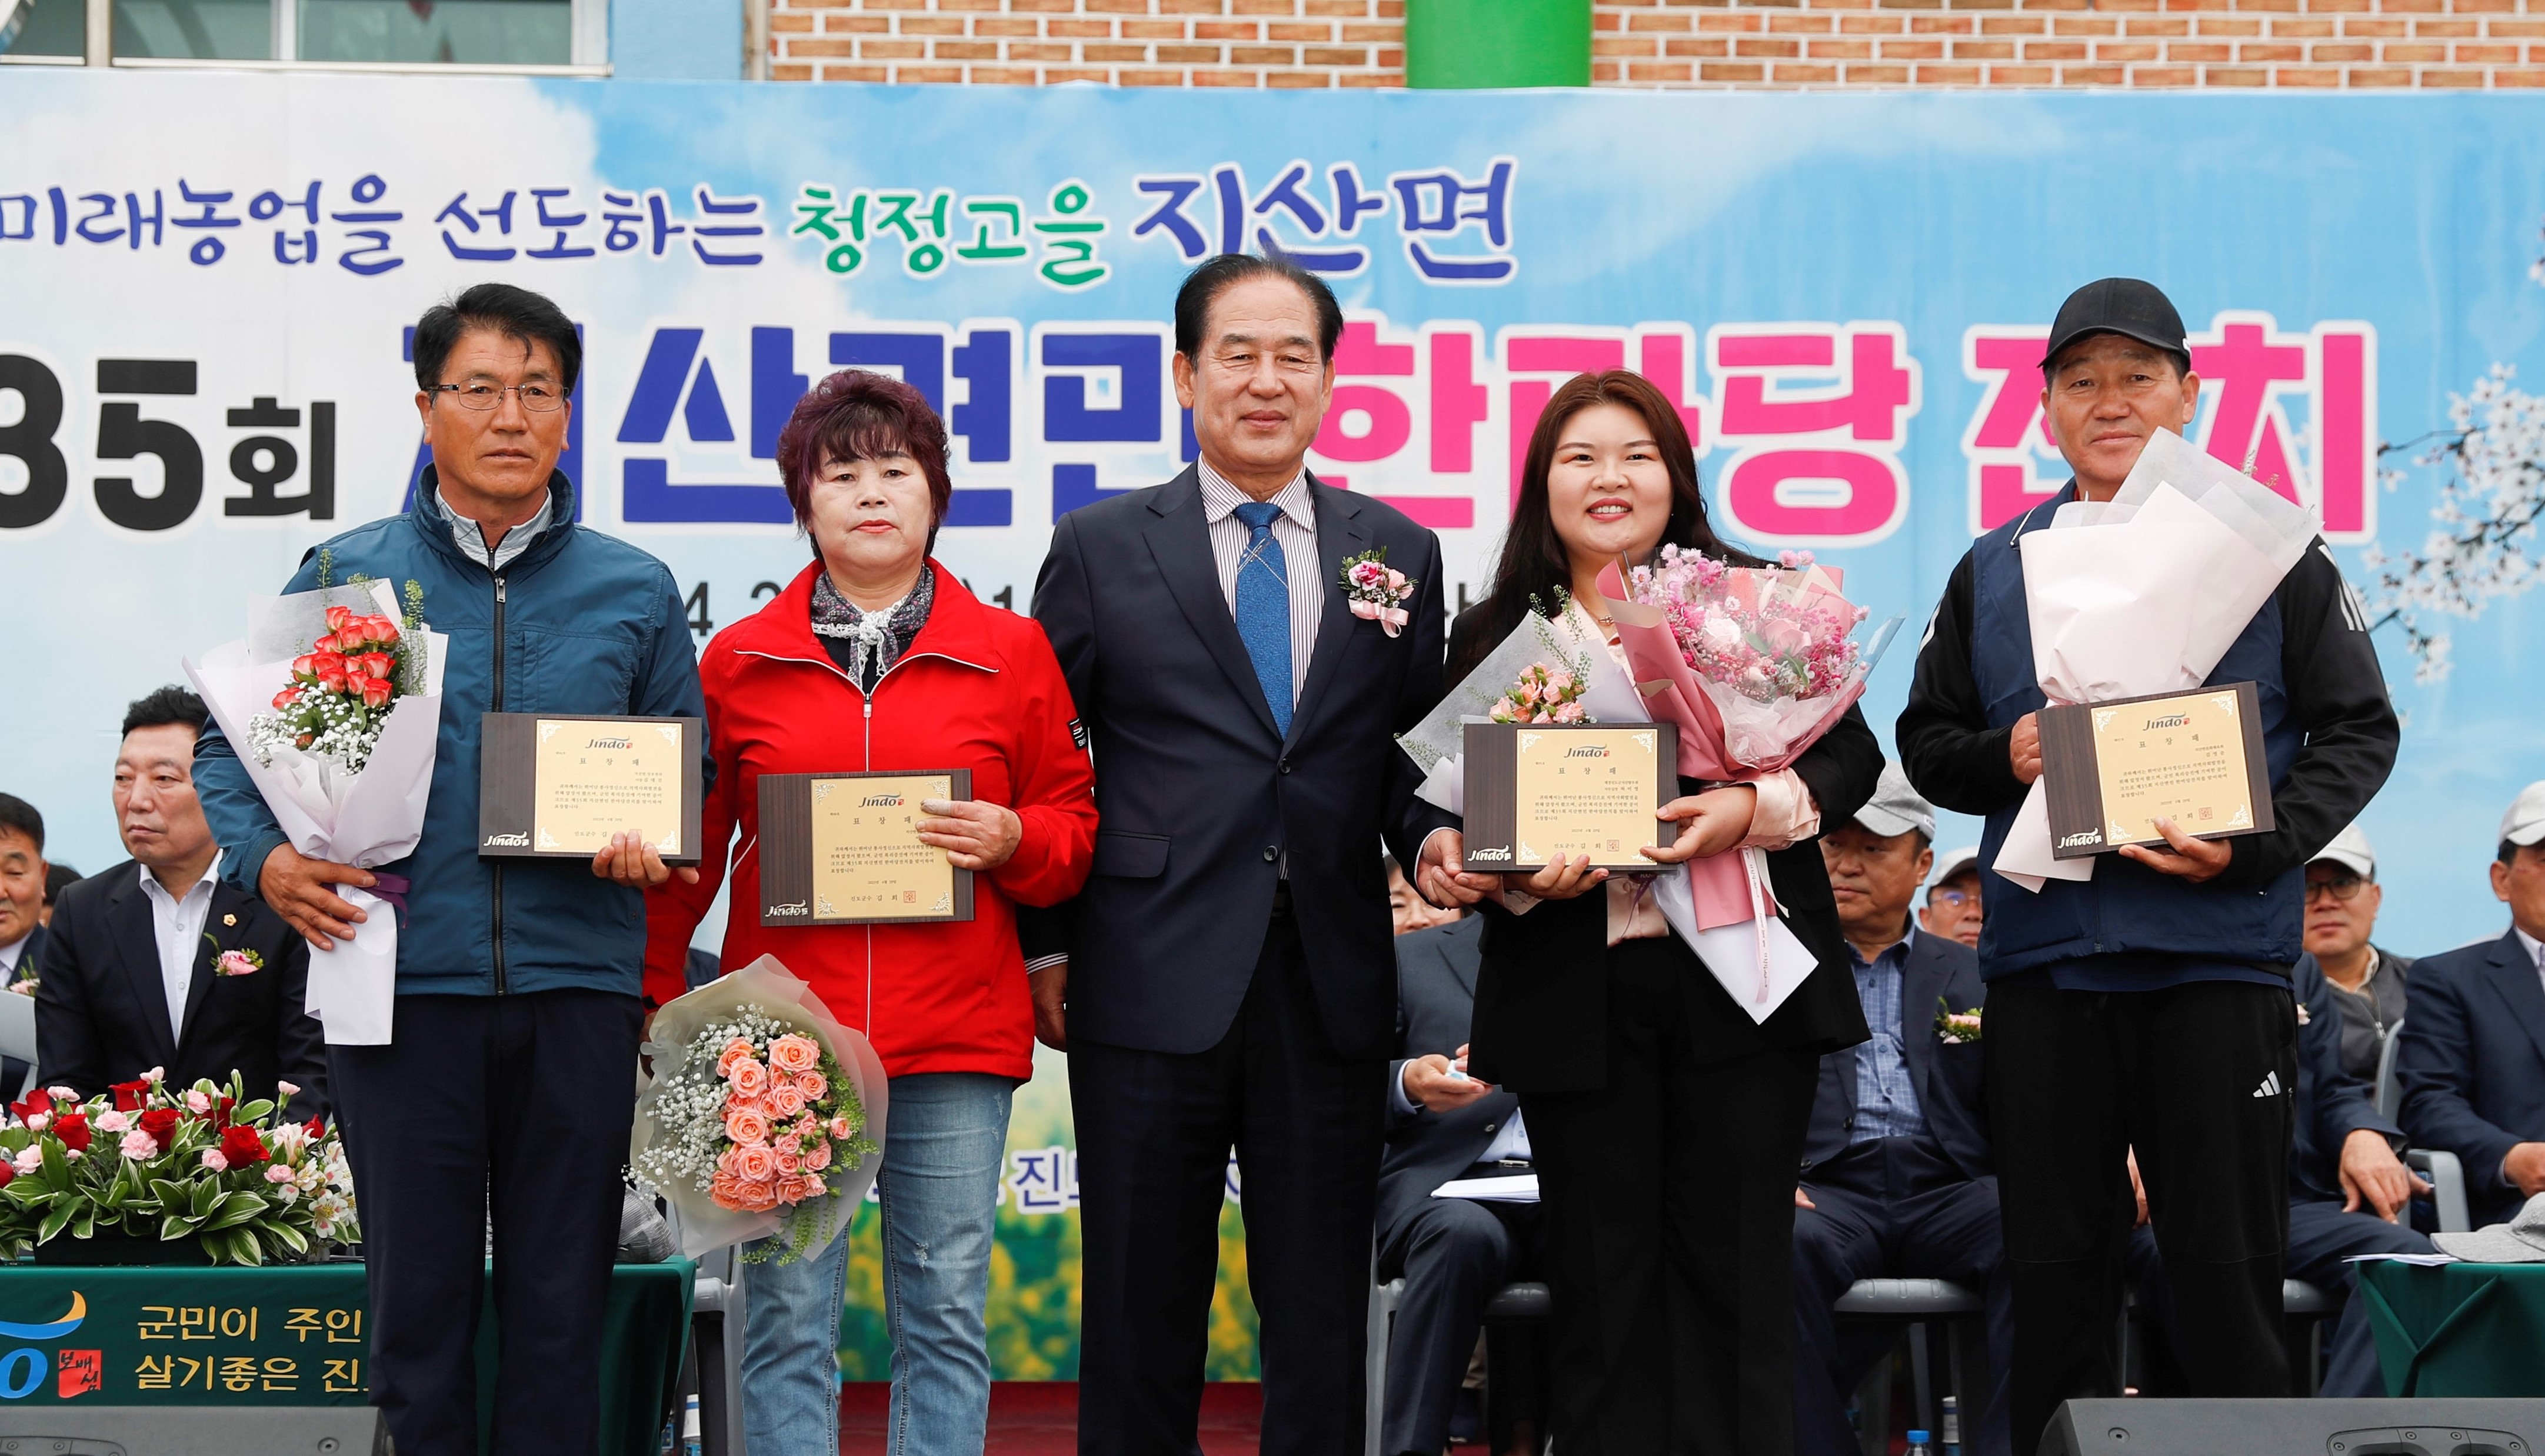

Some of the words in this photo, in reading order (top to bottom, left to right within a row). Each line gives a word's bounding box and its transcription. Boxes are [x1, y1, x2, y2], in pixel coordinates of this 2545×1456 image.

[0, 175, 404, 275] 미래농업을
[434, 187, 764, 266] 선도하는
[793, 178, 1106, 286] 청정고을
[1135, 161, 1513, 279] 지산면
[2143, 718, 2182, 731] Jindo
[585, 738, 625, 749] Jindo
[1564, 748, 1603, 758] Jindo
[858, 796, 897, 808] Jindo
[484, 835, 522, 847] Jindo
[2057, 835, 2094, 849] Jindo
[1468, 849, 1505, 862] Jindo
[765, 905, 801, 917] Jindo
[137, 1305, 258, 1341] 군민이
[284, 1308, 362, 1344] 주인
[135, 1354, 300, 1392] 살기좋은
[321, 1358, 369, 1393] 진
